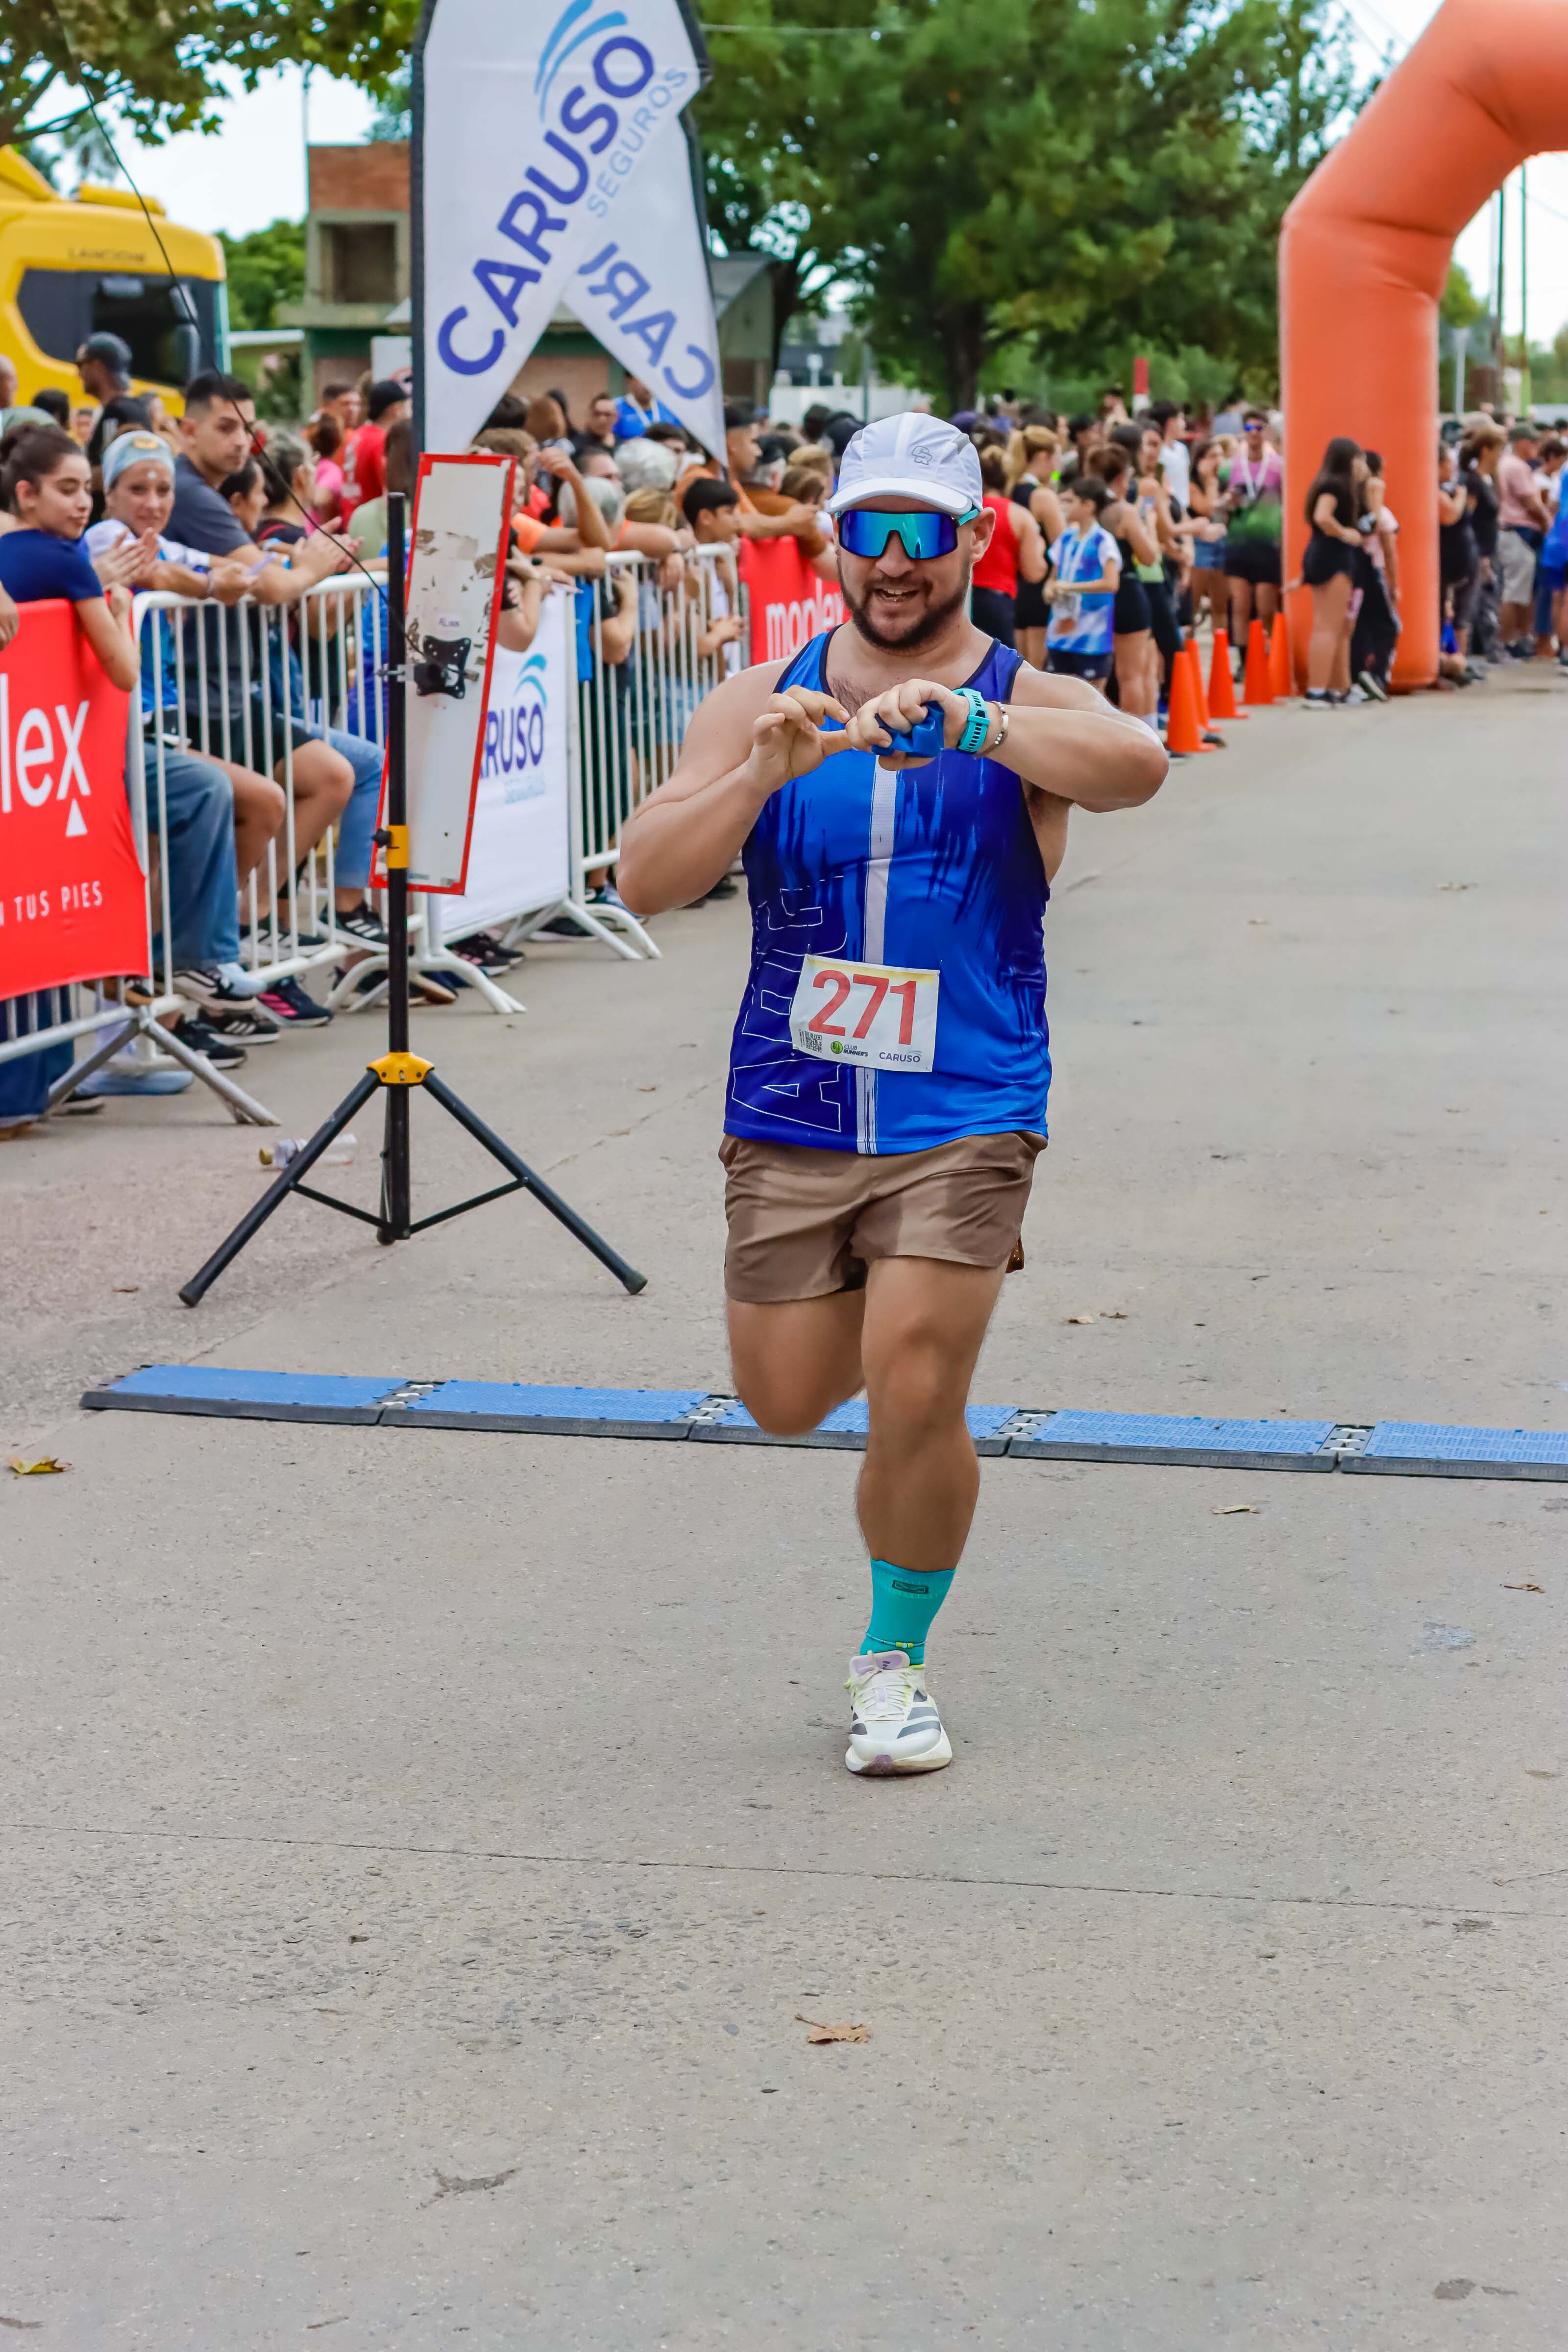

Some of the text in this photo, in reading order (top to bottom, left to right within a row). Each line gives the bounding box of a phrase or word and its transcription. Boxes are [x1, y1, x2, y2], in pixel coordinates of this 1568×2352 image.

[587, 67, 688, 219] SEGUROS
[438, 36, 655, 375] CARUSO
[481, 703, 544, 779] RUSO
[14, 890, 50, 922] TUS
[61, 880, 103, 911] PIES
[808, 969, 917, 1045] 271
[879, 1052, 921, 1063] CARUSO
